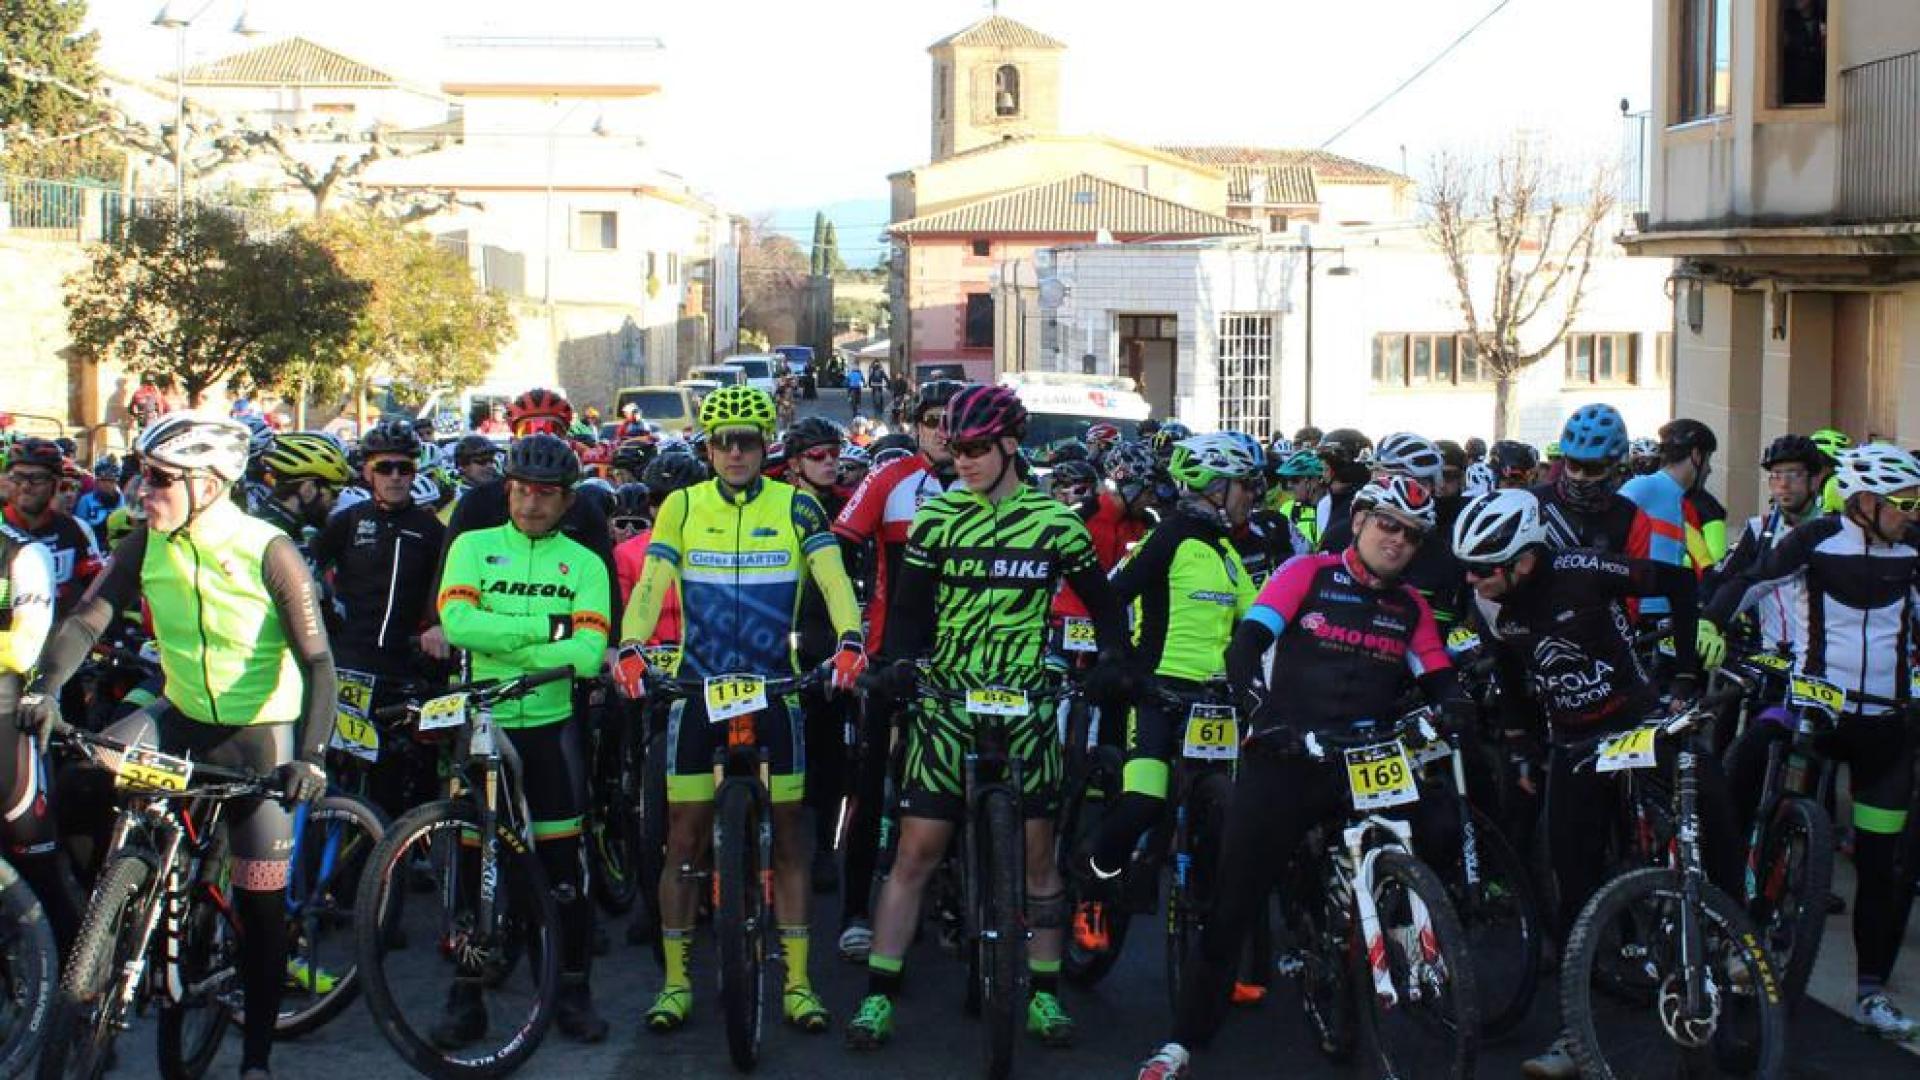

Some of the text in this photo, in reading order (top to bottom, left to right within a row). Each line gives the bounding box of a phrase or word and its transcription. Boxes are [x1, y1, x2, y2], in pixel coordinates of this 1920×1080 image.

[943, 558, 1050, 578] APL BIKE
[716, 683, 756, 701] 118
[1808, 686, 1834, 701] 10
[349, 720, 366, 738] 17
[1201, 723, 1224, 742] 61
[1359, 762, 1403, 788] 169
